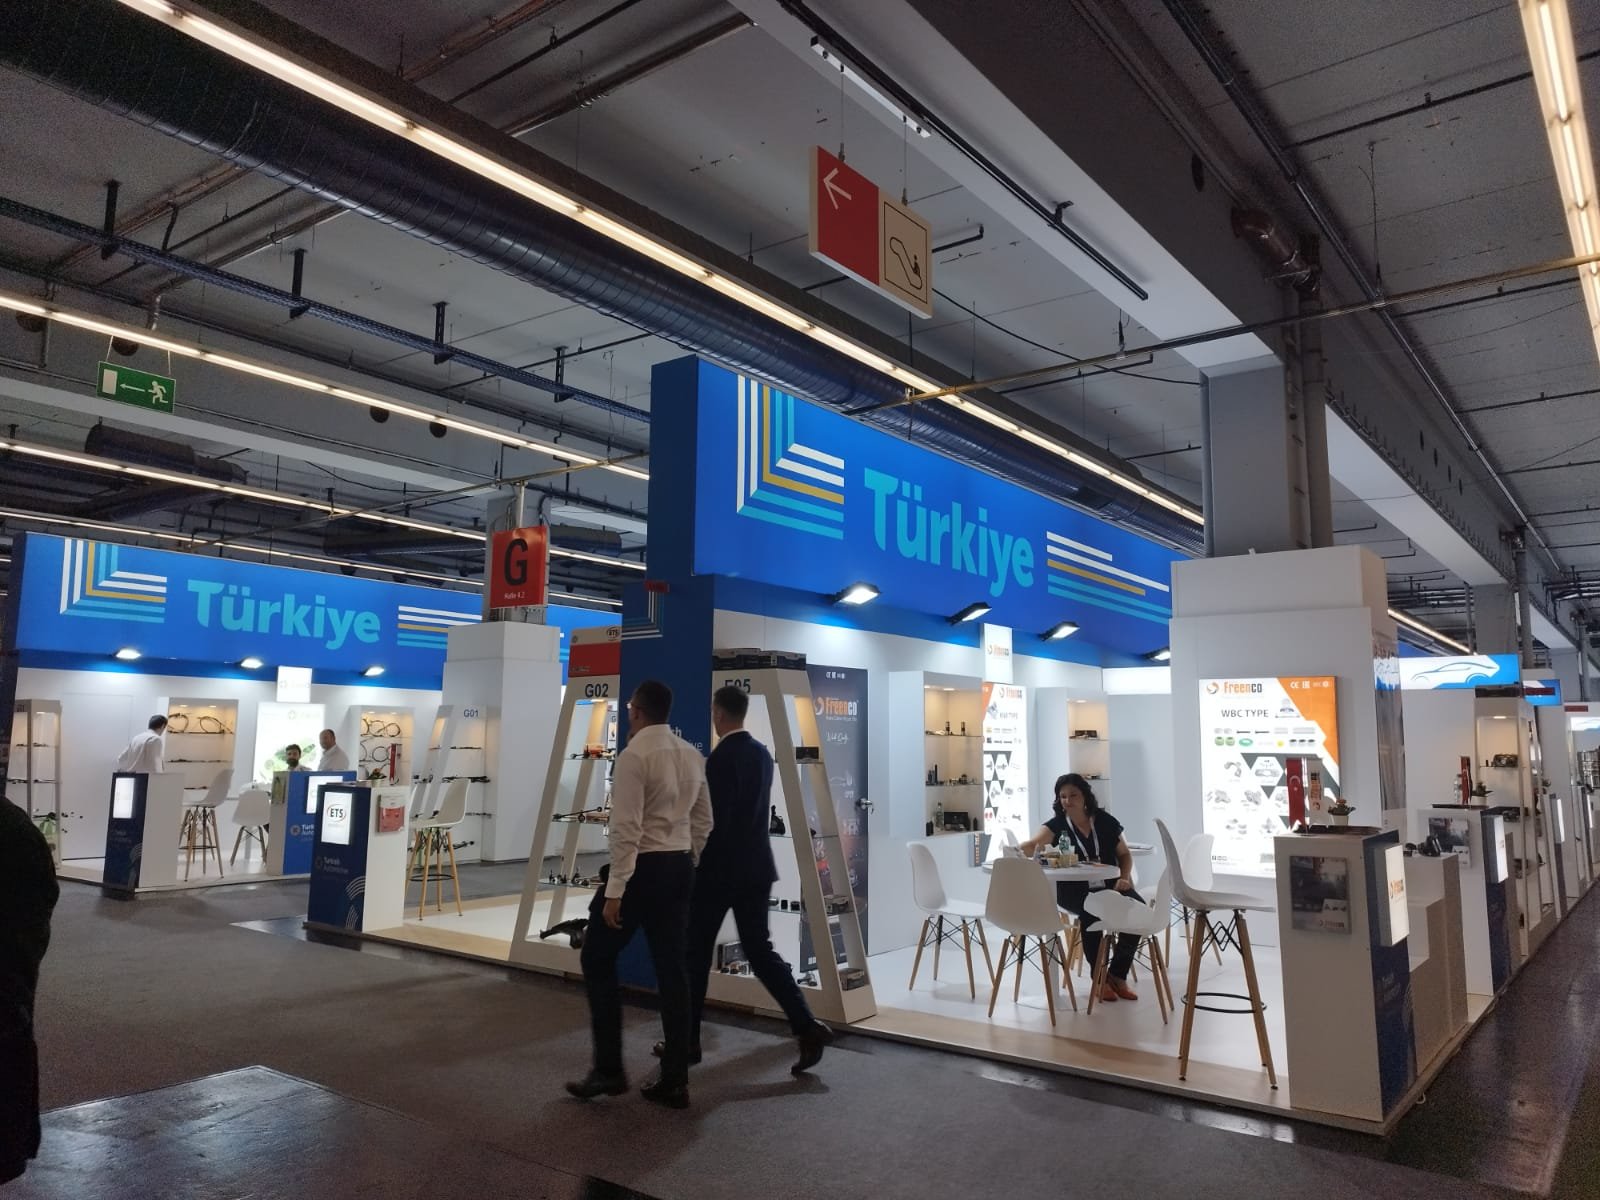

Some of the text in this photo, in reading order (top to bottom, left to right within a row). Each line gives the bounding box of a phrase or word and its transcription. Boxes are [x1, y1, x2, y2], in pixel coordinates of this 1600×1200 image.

[864, 467, 1034, 598] Türkiye
[504, 538, 528, 586] G
[187, 579, 381, 650] Türkiye
[584, 683, 609, 698] G02
[463, 709, 479, 718] G01
[1221, 709, 1269, 718] WBC TYPE
[330, 808, 344, 818] ETS
